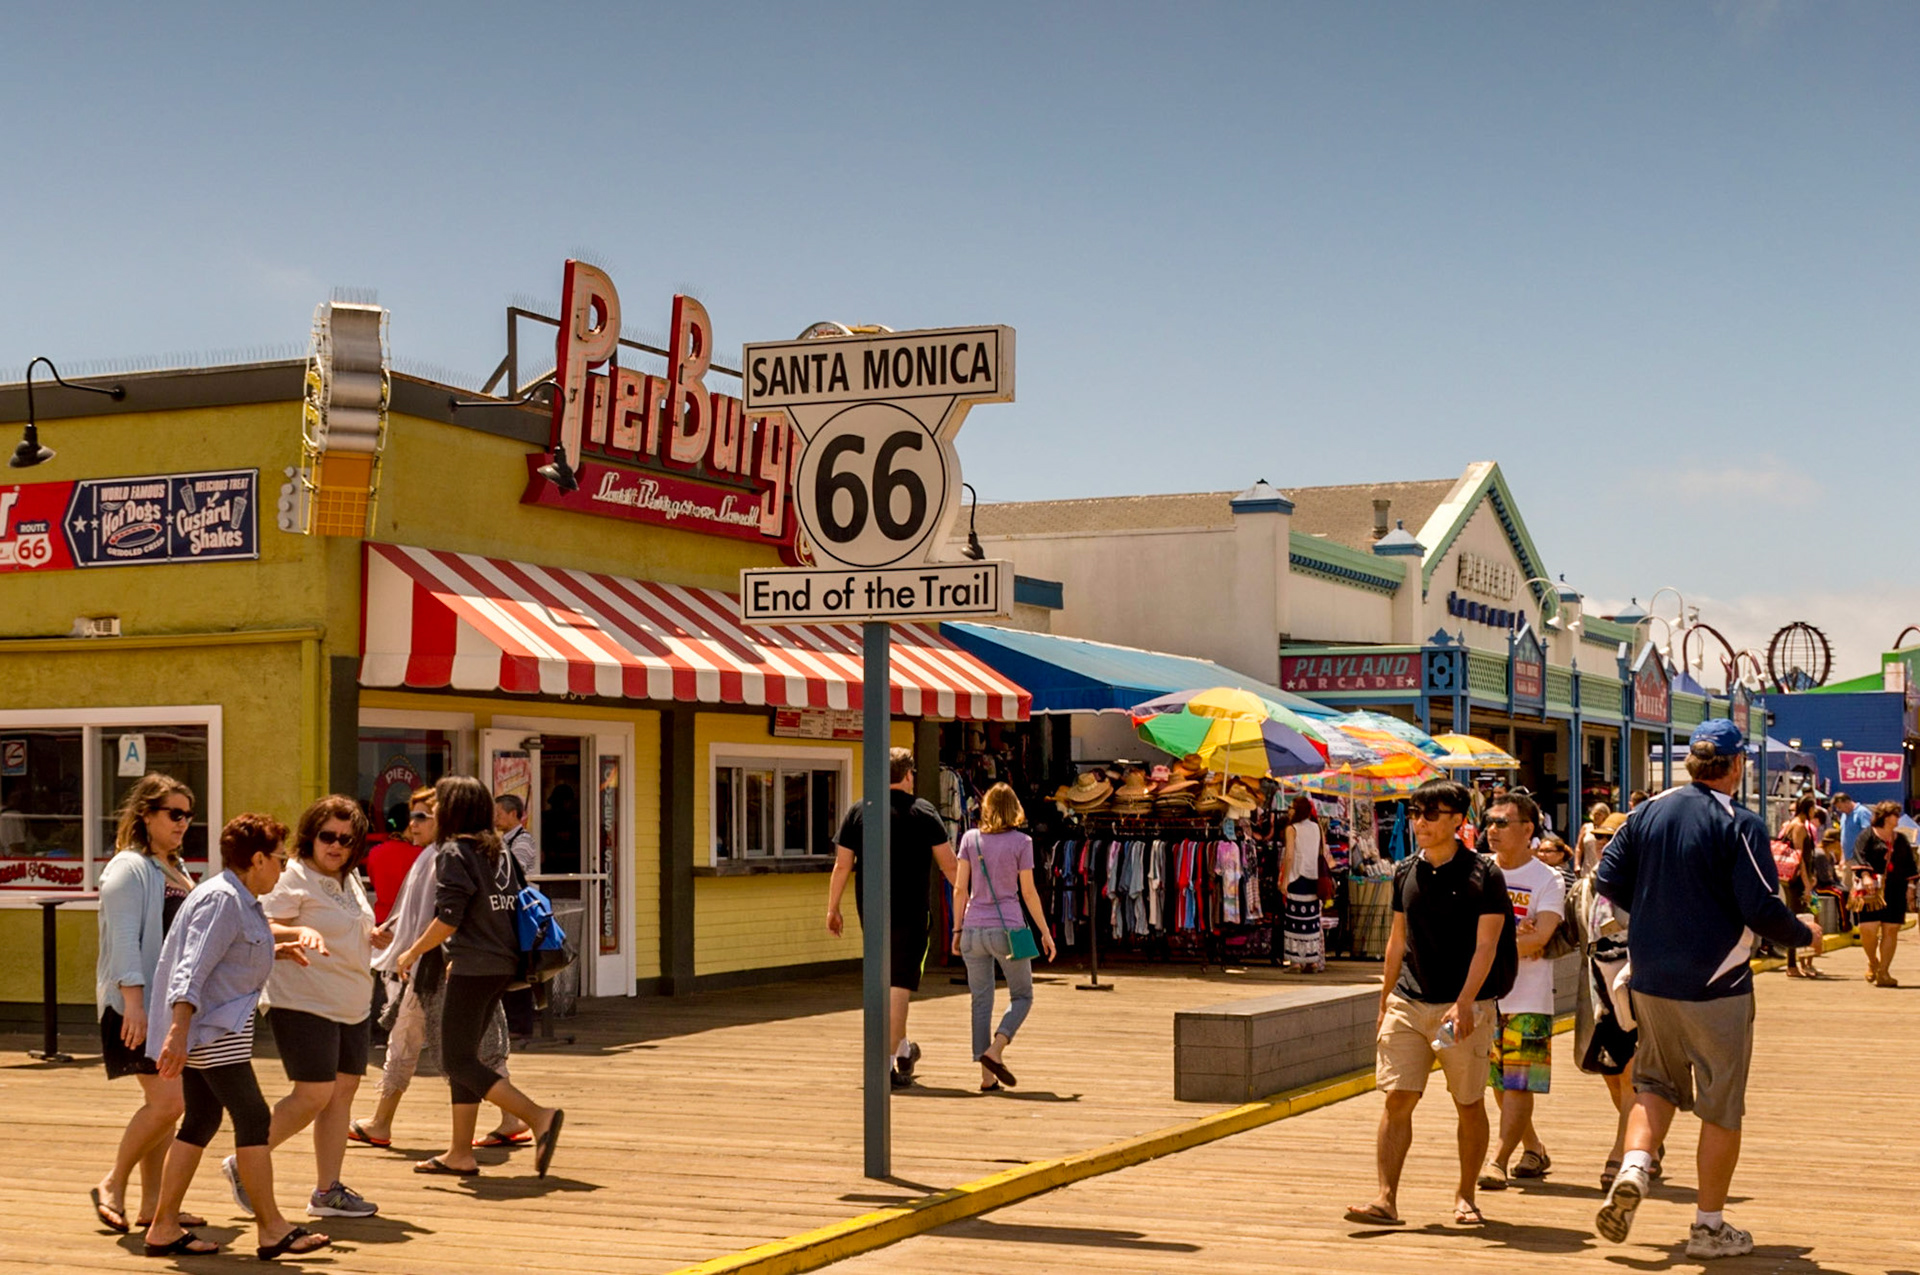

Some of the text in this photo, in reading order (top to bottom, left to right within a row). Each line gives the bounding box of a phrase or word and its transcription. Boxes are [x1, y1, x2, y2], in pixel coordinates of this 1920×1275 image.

[555, 258, 671, 473] Pier
[752, 342, 992, 397] SANTA MONICA
[101, 484, 166, 502] WORLD FAMOUS
[229, 478, 249, 490] TREAT
[815, 430, 927, 543] 66
[20, 523, 46, 533] ROUTE
[102, 500, 161, 545] Hot Dogs
[176, 500, 231, 538] Custard
[18, 538, 46, 559] 66
[189, 526, 243, 555] Shakes
[753, 571, 989, 611] End of the Trail
[1294, 657, 1410, 678] PLAYLAND
[1298, 677, 1405, 689] ARCADE
[125, 741, 139, 762] A
[1853, 755, 1884, 769] Gift
[385, 768, 413, 784] PIER
[1846, 767, 1887, 780] Shop
